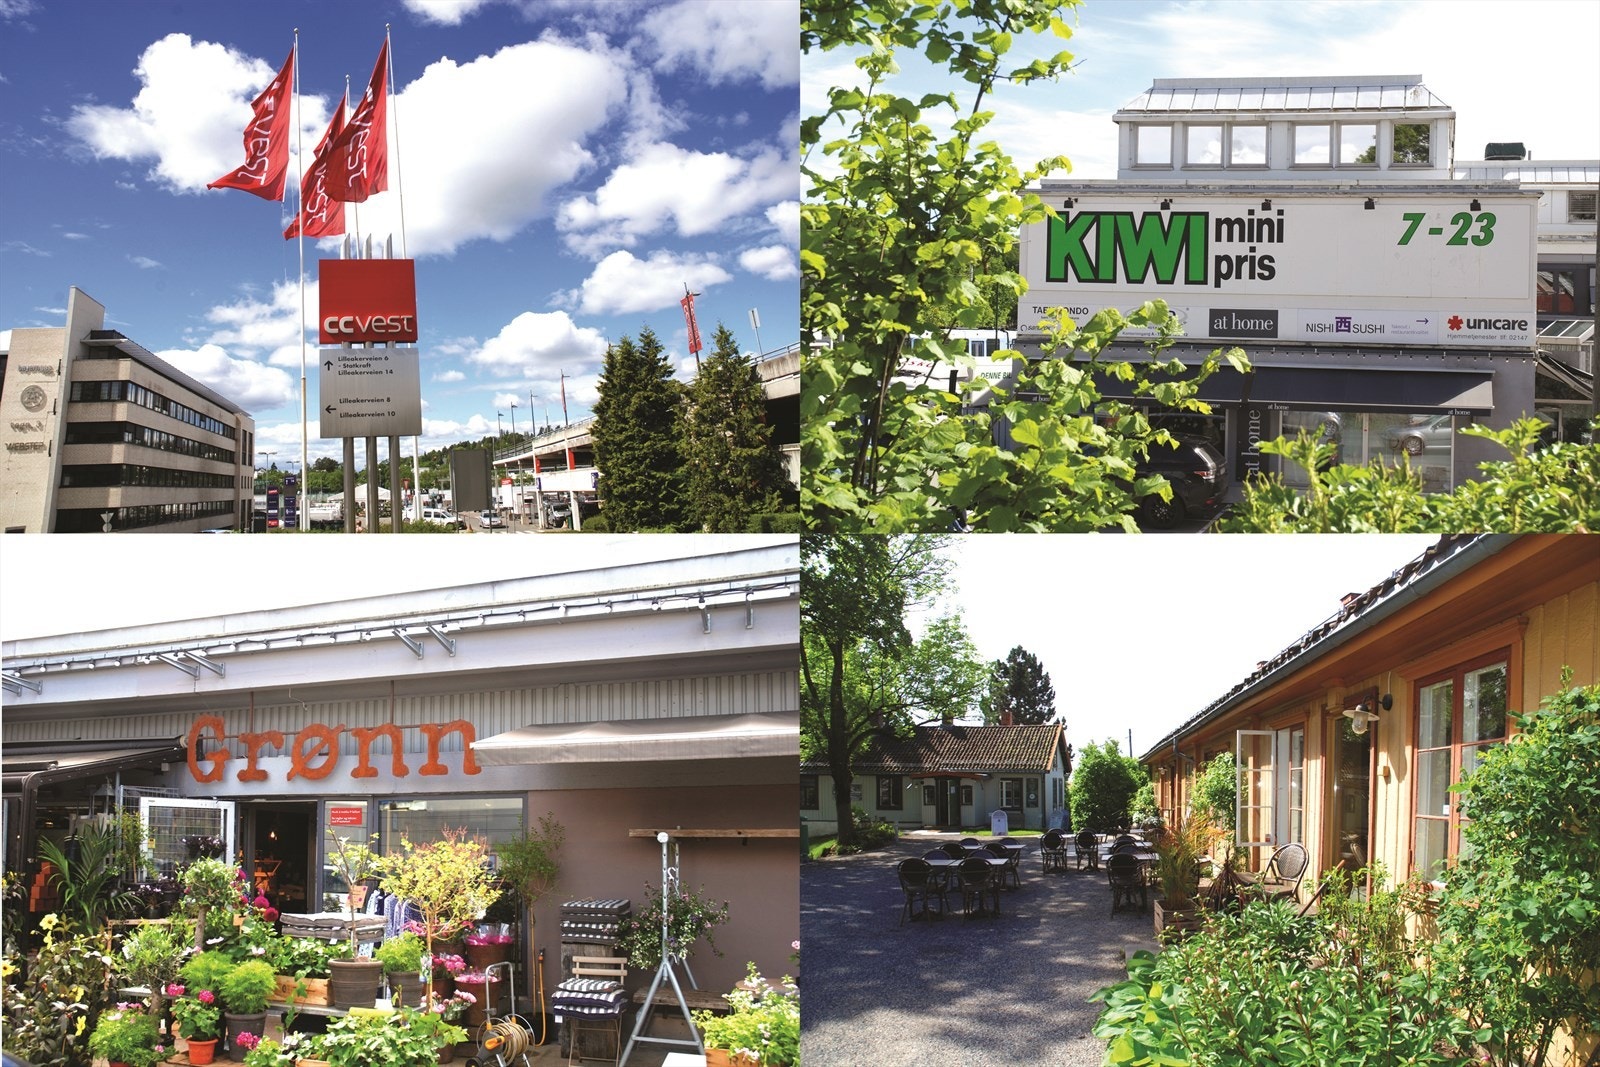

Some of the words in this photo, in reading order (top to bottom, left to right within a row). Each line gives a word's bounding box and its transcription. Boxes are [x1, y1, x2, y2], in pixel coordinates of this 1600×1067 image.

[1215, 209, 1285, 243] mini
[1046, 211, 1209, 285] KIWI
[1214, 246, 1276, 288] pris
[1032, 306, 1089, 315] TAEONDO
[1213, 316, 1228, 330] at
[1231, 312, 1274, 331] home
[1466, 318, 1528, 331] unicare
[1306, 323, 1334, 333] NISHI
[1352, 323, 1385, 334] SUSHI
[1241, 410, 1261, 457] home
[187, 714, 482, 783] Grønn
